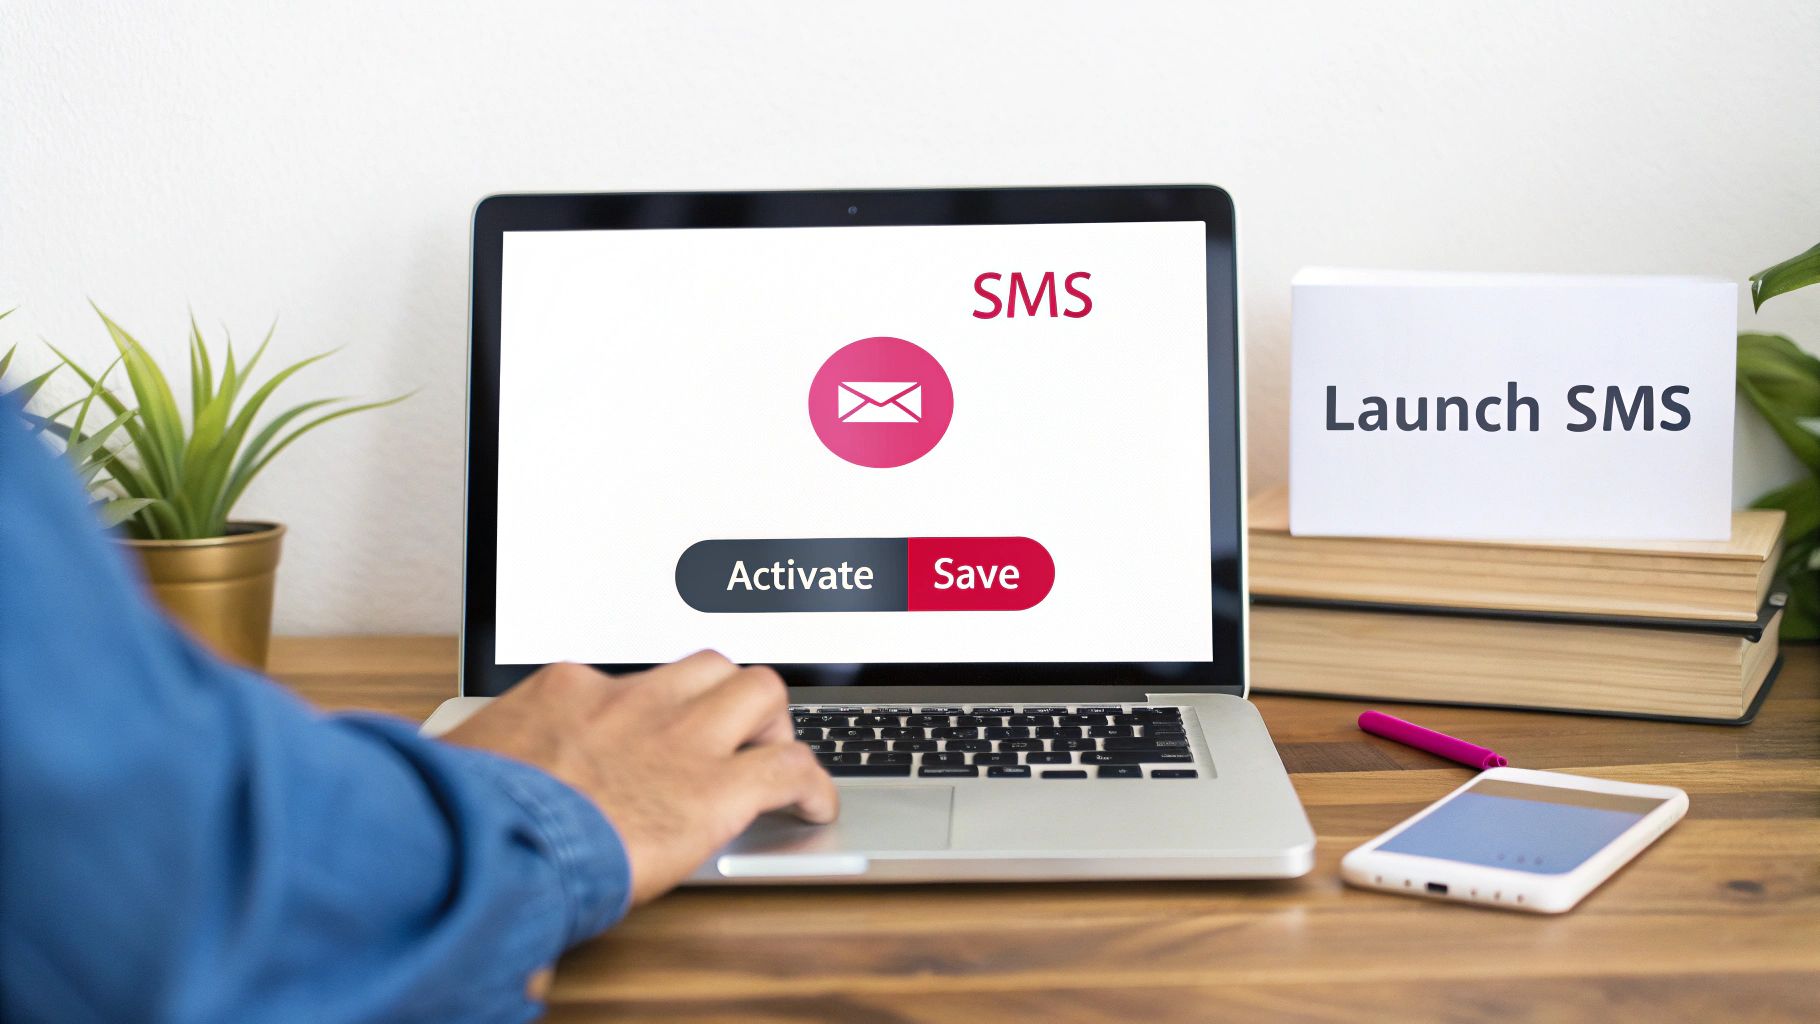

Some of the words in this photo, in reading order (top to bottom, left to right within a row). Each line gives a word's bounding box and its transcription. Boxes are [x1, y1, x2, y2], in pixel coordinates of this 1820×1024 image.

[972, 271, 1093, 320] SMS
[1325, 381, 1540, 433] Launch
[1566, 384, 1691, 433] SMS
[726, 558, 874, 591] Activate
[933, 557, 1020, 590] Save
